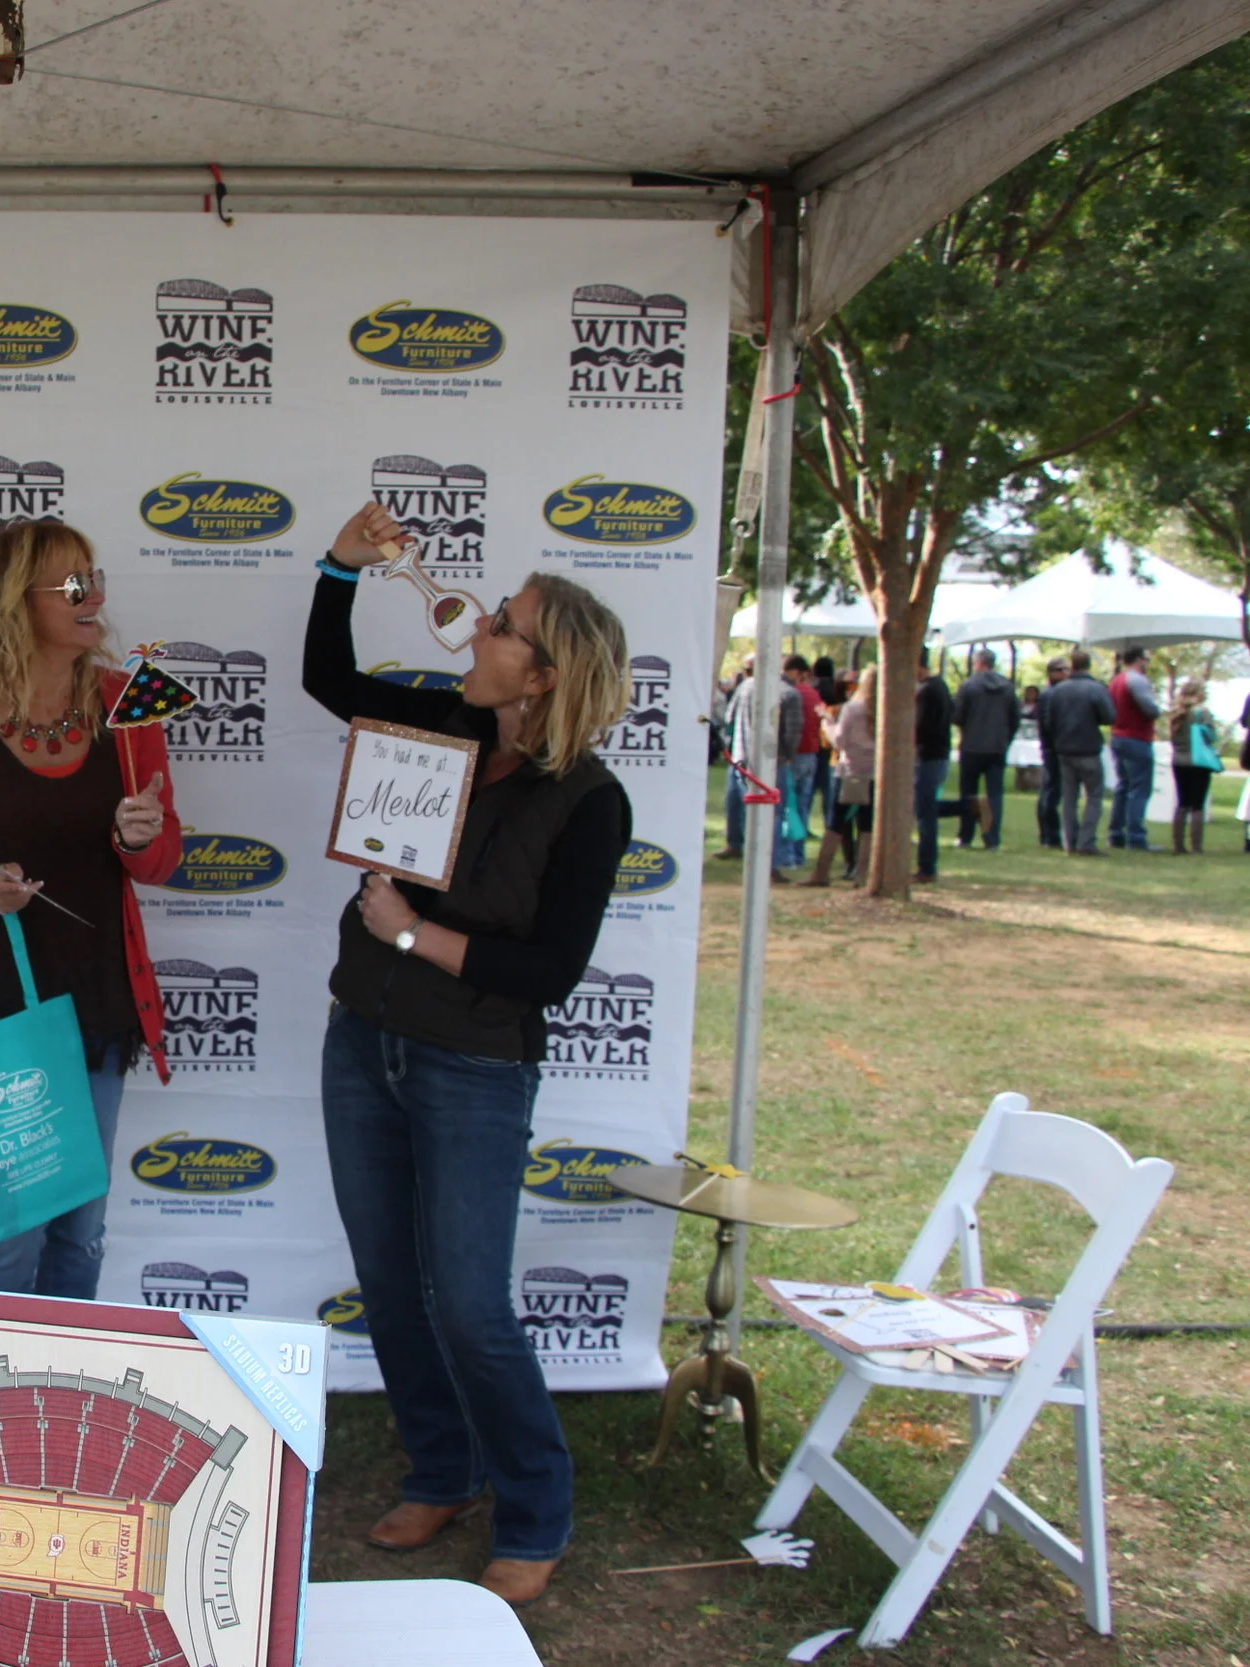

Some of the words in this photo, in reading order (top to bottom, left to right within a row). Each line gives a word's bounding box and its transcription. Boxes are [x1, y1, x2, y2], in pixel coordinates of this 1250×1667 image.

[156, 314, 273, 343] WINE
[356, 302, 492, 354] Schmitt
[571, 318, 686, 349] WINE
[402, 346, 471, 358] Furniture
[155, 361, 272, 388] RIVER
[568, 365, 684, 394] RIVER
[155, 395, 272, 405] LOUISVILLE
[568, 400, 682, 410] LOUISVILLE
[147, 474, 281, 524] Schmitt
[372, 490, 486, 518] WINE
[549, 476, 684, 527] Schmitt
[193, 518, 261, 529] Furniture
[595, 520, 663, 531] Furniture
[393, 743, 411, 765] had
[417, 754, 431, 768] me
[346, 777, 452, 826] Merlot
[186, 838, 272, 866] chmitt
[186, 870, 255, 881] Furniture
[146, 1064, 256, 1072] LUISVILLE
[550, 1070, 649, 1080] OUISVILLE
[0, 1140, 18, 1155] Dr.
[137, 1134, 264, 1178] Schmitt
[180, 1172, 245, 1182] Furniture
[522, 1294, 626, 1316] WINE
[278, 1342, 312, 1376] 3D
[223, 1334, 264, 1393] STADIUM
[260, 1373, 308, 1434] REPLICAS
[118, 1524, 131, 1579] INDIANA
